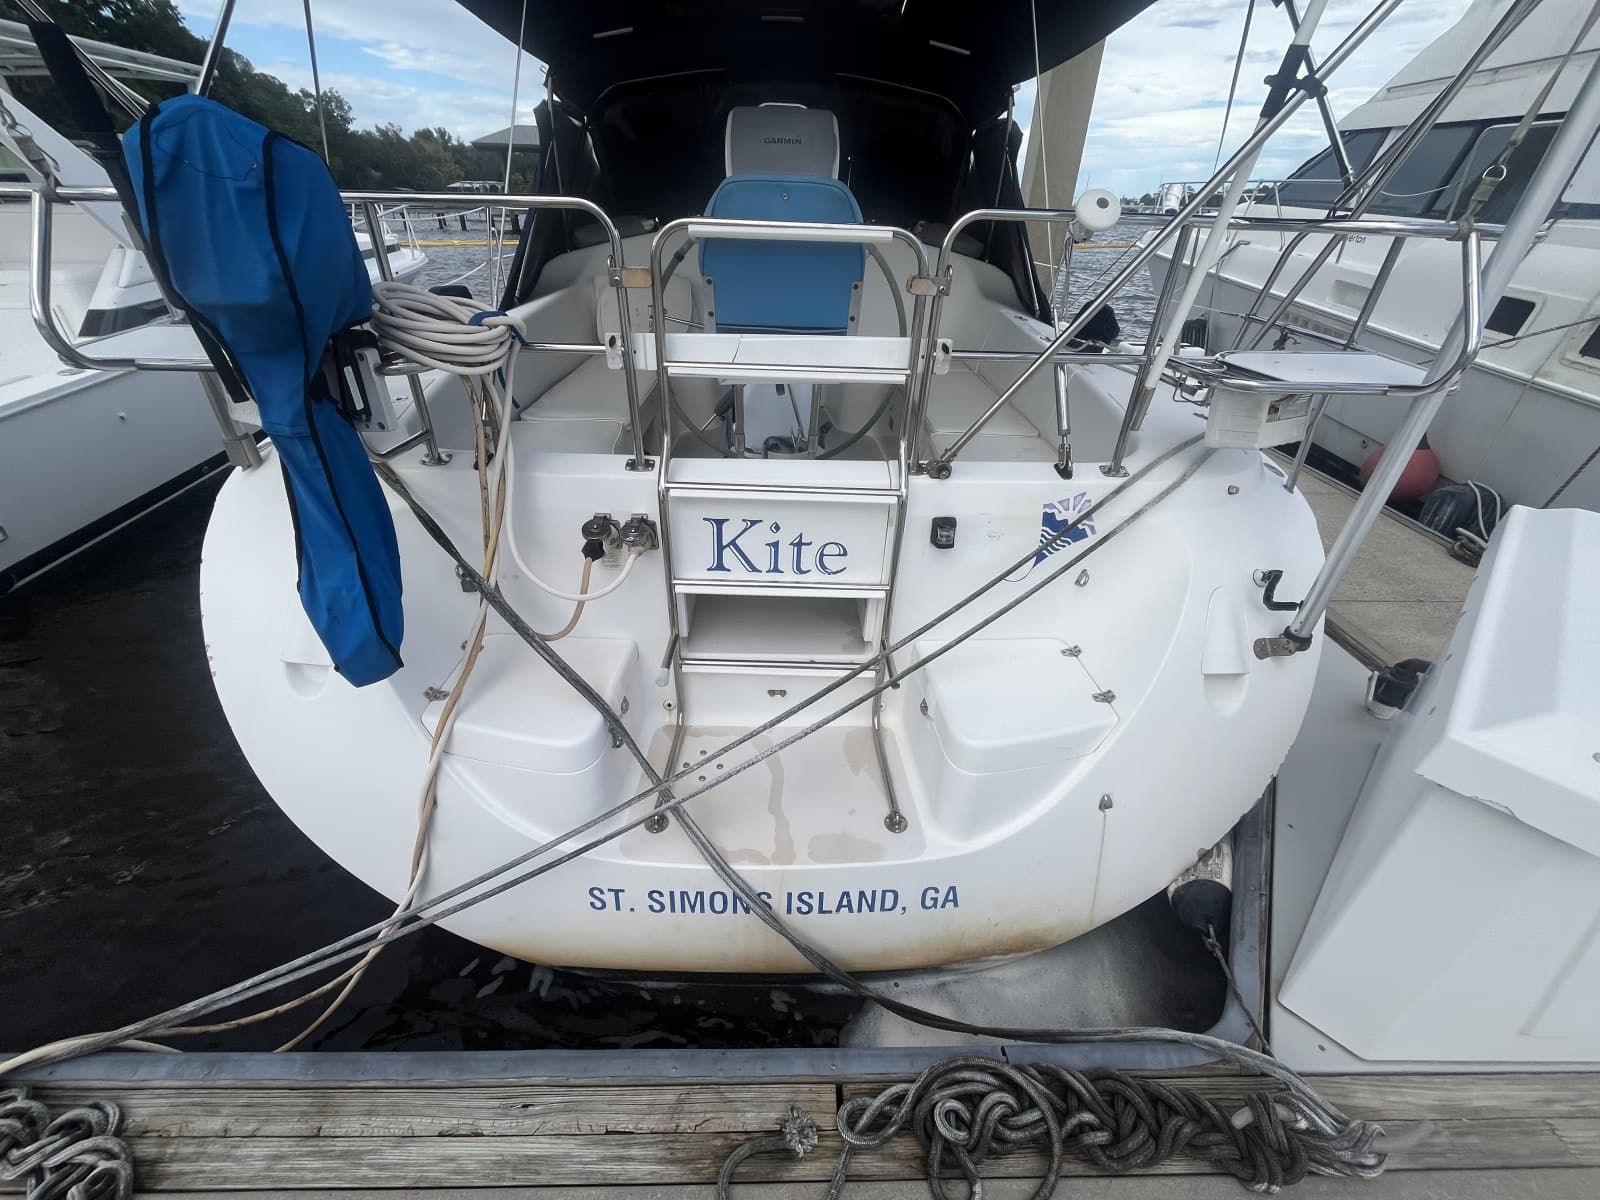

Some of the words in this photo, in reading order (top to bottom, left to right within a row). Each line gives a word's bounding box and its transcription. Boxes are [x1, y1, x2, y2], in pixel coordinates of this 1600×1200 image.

[763, 137, 802, 145] GARMIN
[702, 517, 848, 575] Kite
[588, 886, 635, 912] ST.
[647, 889, 773, 915] SIMONS
[786, 889, 907, 916] ISLAND,
[920, 885, 959, 911] GA
